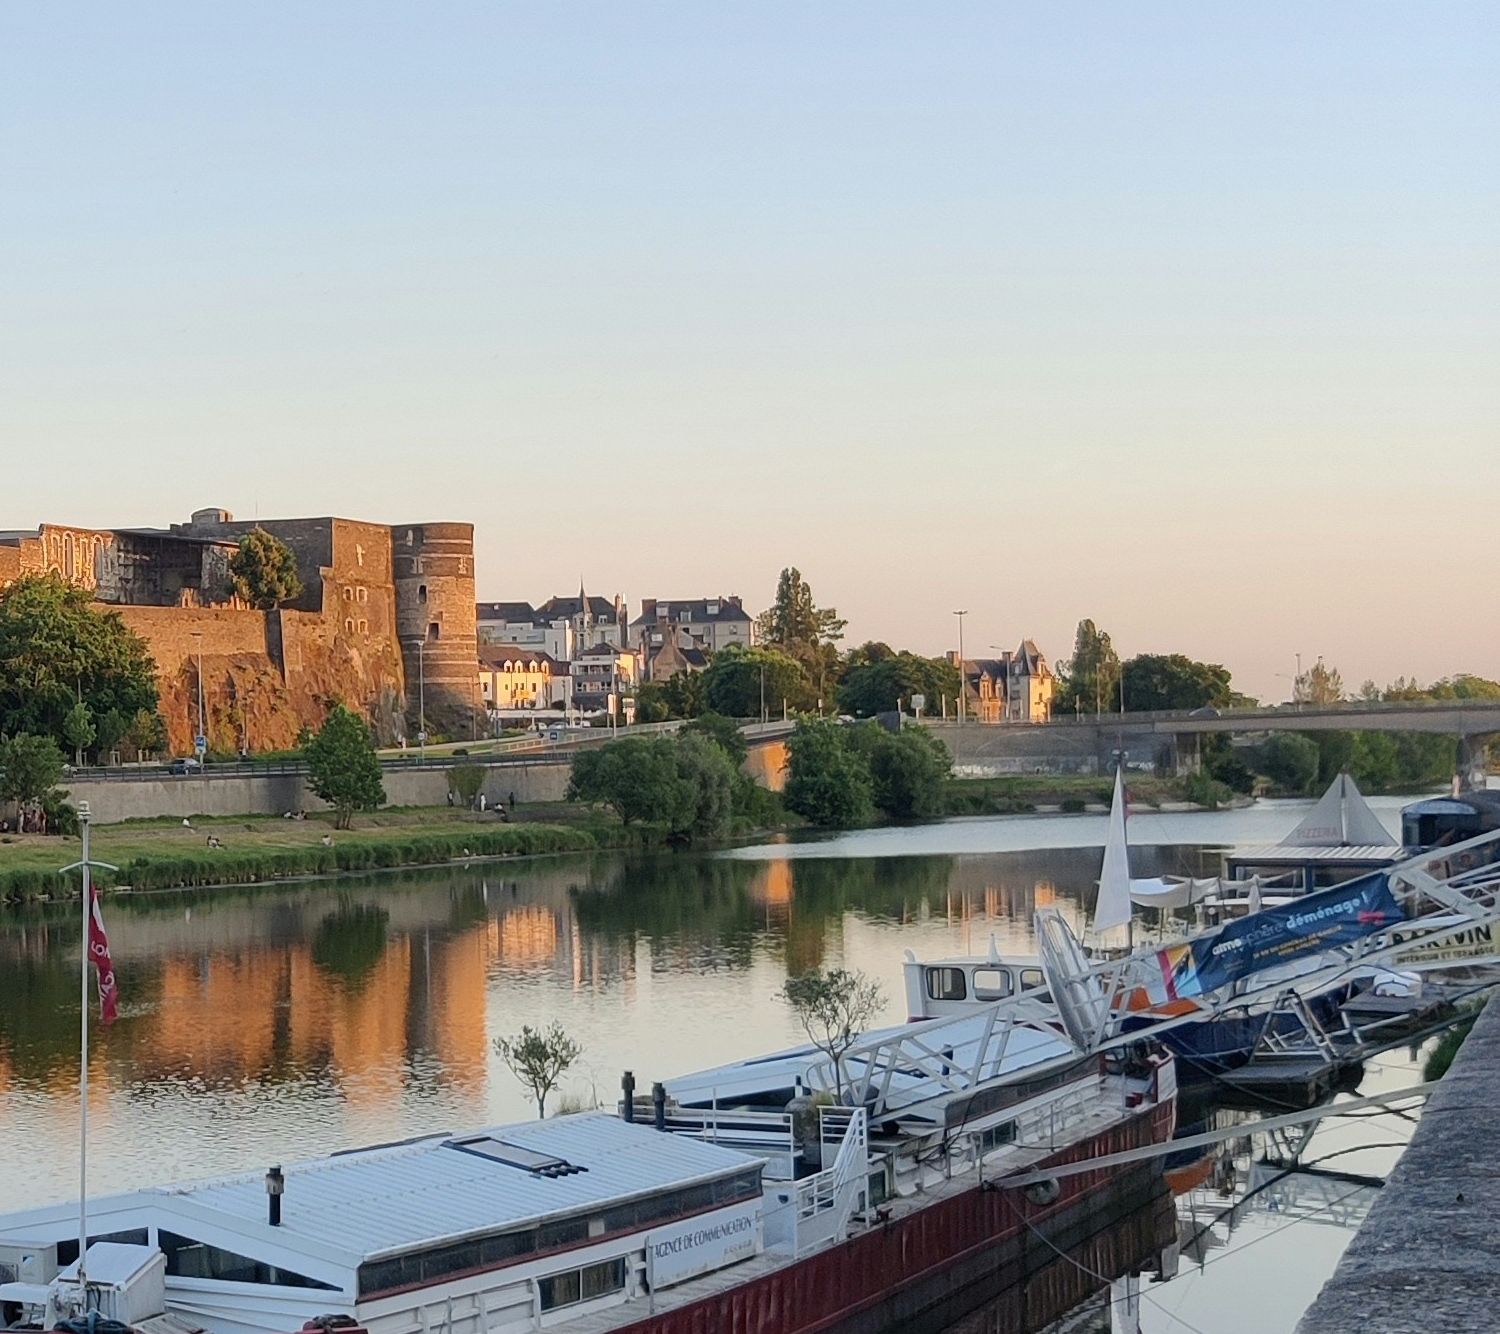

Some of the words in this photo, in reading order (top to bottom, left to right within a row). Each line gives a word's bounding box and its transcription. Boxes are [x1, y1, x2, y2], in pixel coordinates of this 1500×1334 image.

[655, 1236, 682, 1258] AGENCE
[684, 1233, 693, 1250] DE
[694, 1216, 752, 1247] COMMUNICATION
